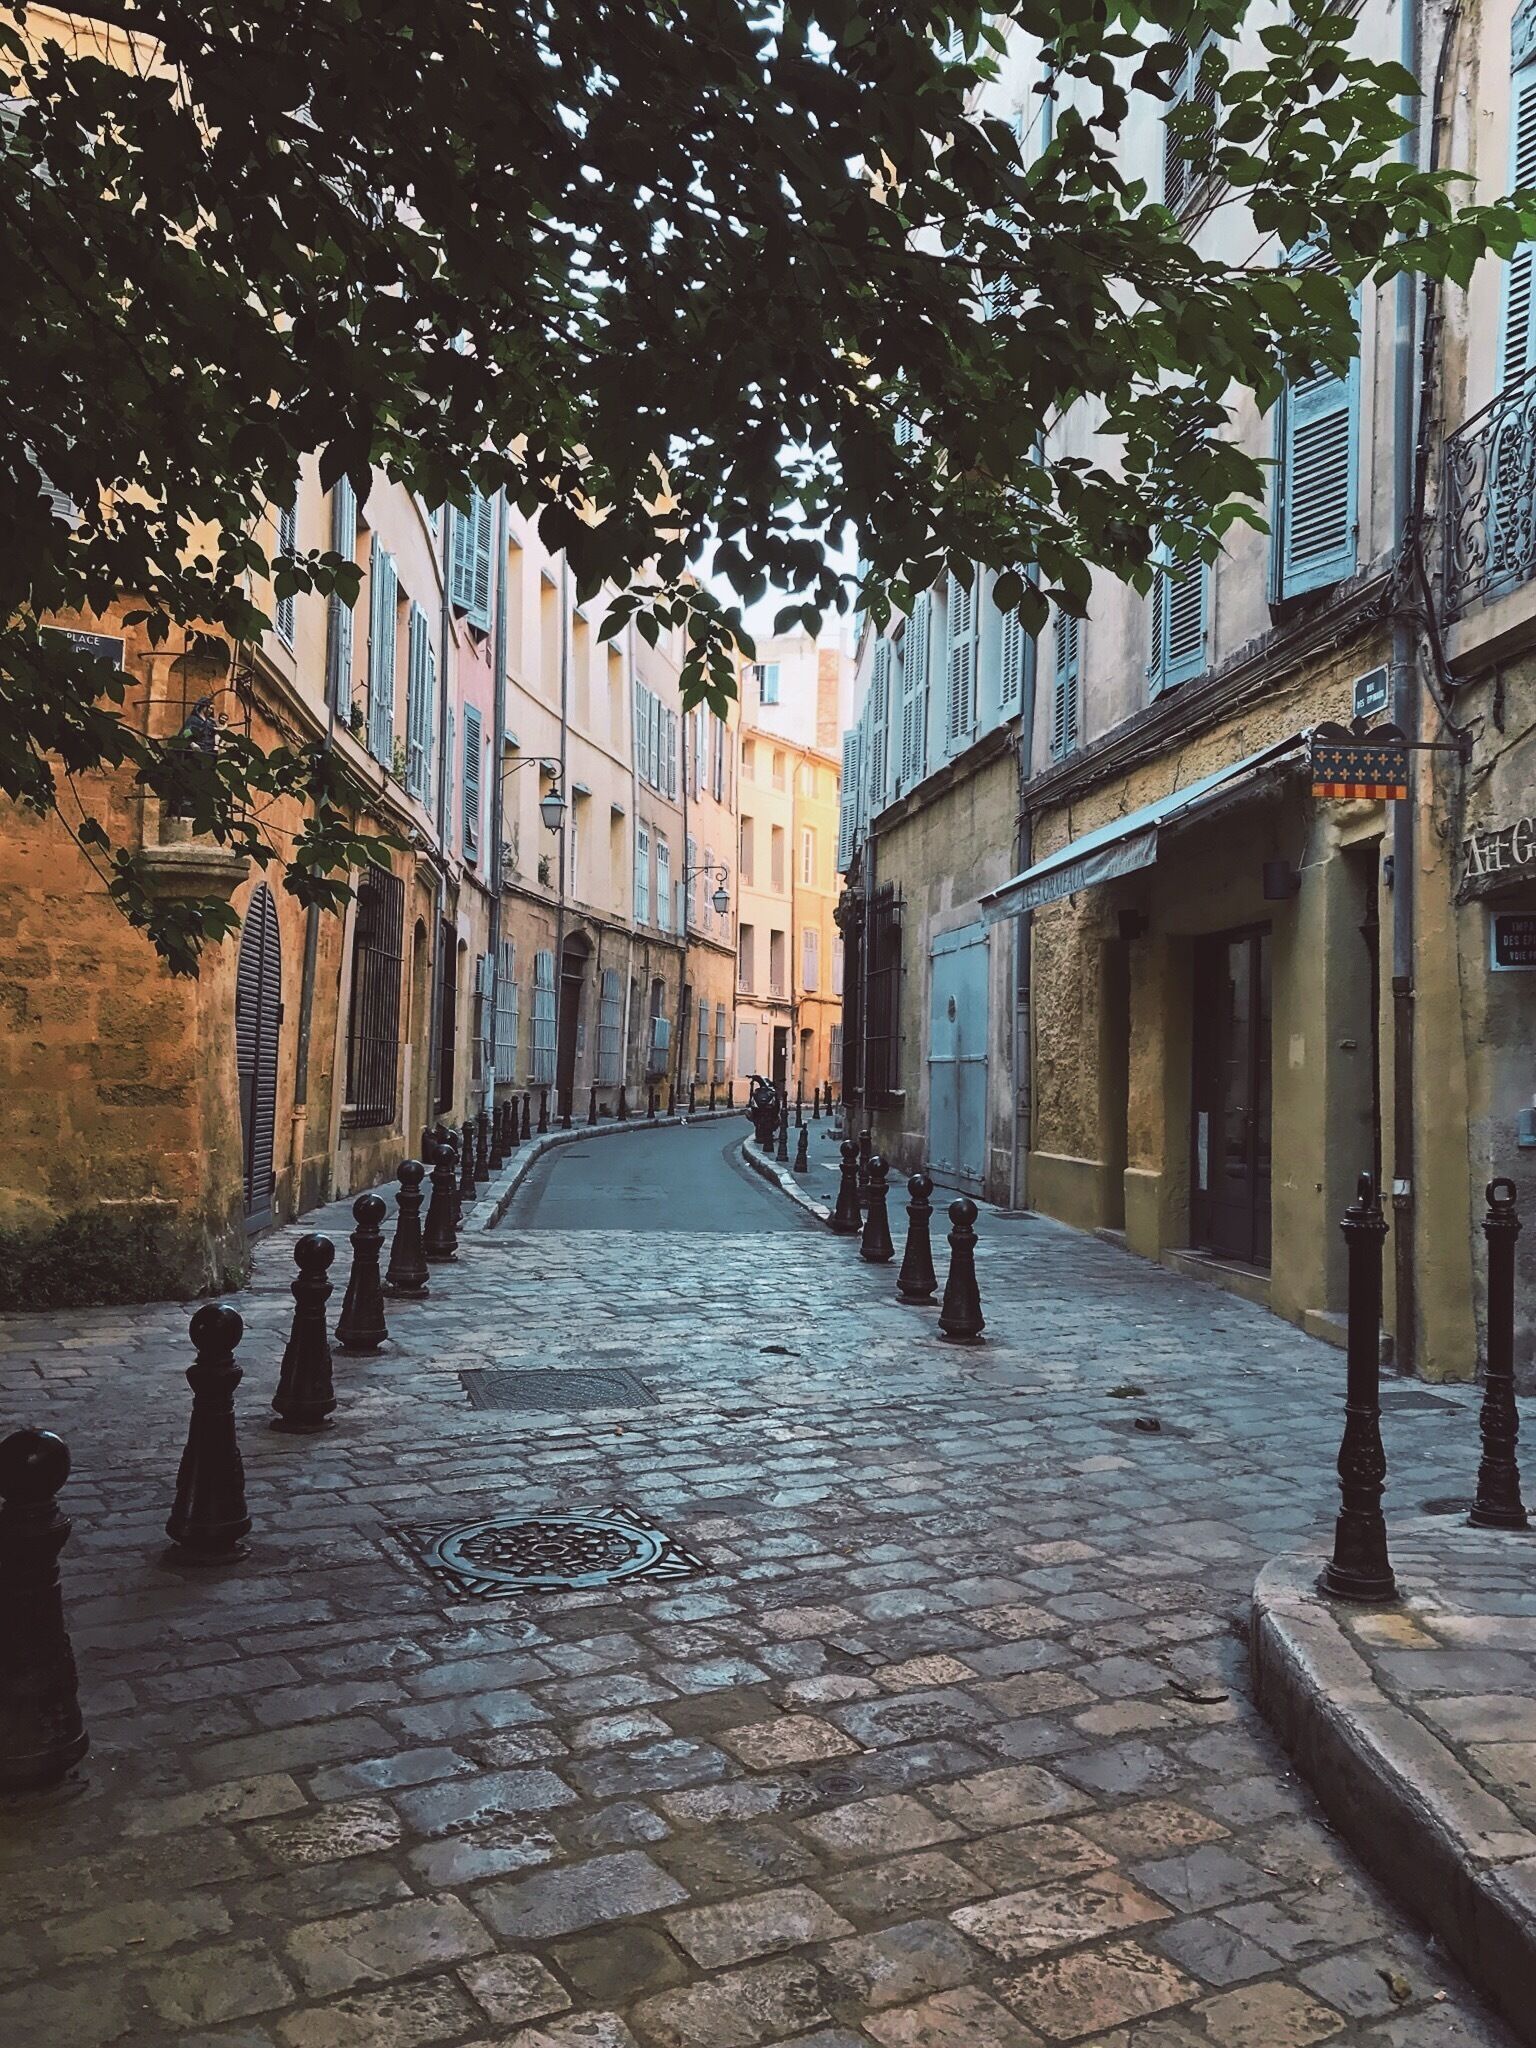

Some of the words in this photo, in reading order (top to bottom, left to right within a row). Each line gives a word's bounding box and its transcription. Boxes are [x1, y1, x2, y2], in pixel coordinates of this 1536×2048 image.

[66, 632, 101, 646] PLACE
[1366, 682, 1375, 693] RUE
[1356, 698, 1365, 710] DES
[1465, 832, 1510, 878] Art
[1043, 864, 1087, 902] ORMEAUX
[1503, 935, 1520, 946] DES
[1509, 951, 1527, 961] VOIE
